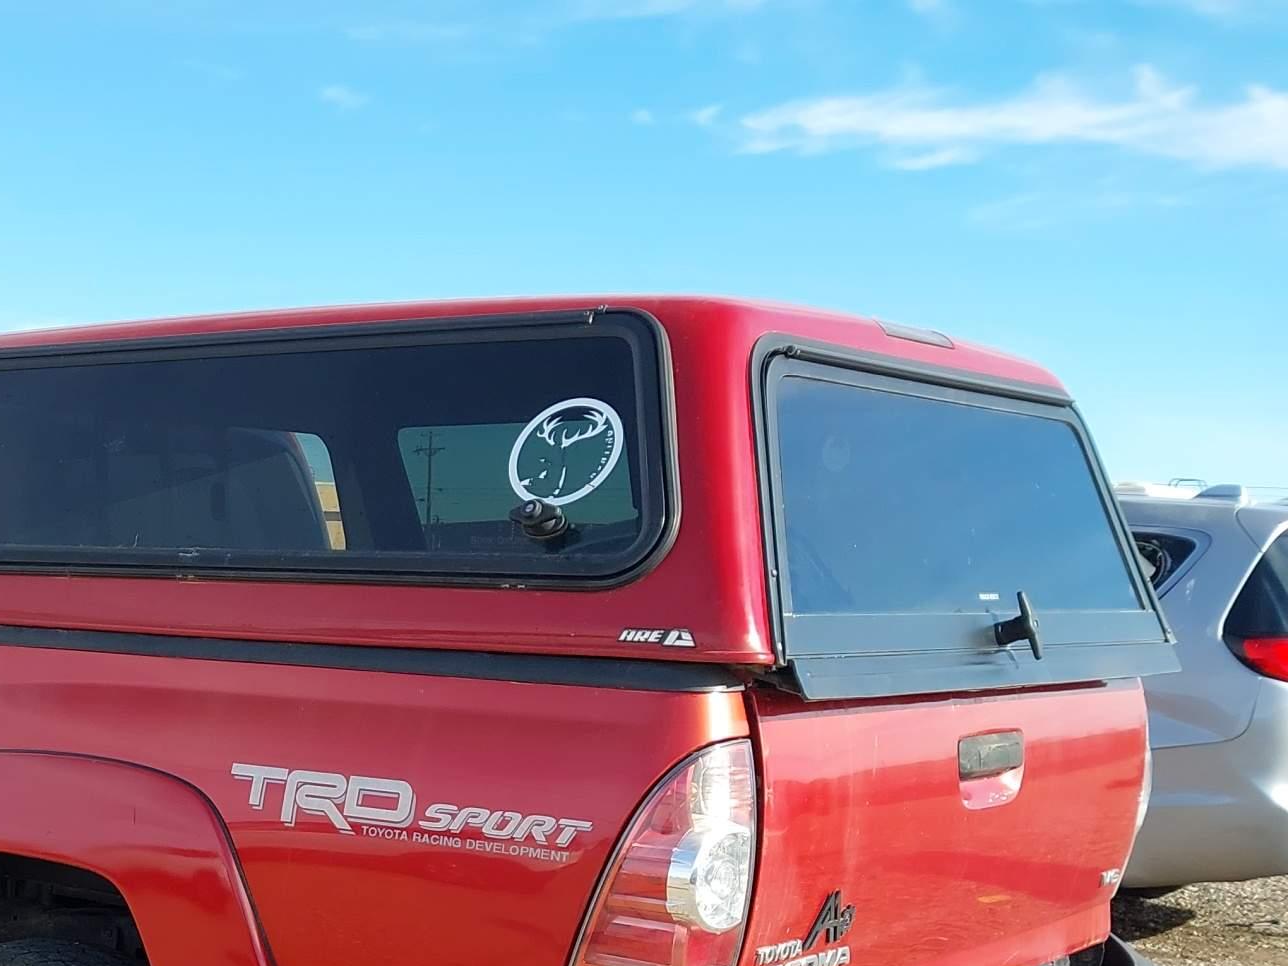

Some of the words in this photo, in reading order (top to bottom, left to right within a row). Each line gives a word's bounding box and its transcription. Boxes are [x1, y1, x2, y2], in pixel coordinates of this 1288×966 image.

[618, 629, 665, 642] ARE
[230, 762, 417, 836] TRD
[418, 803, 593, 848] SPORT
[361, 825, 409, 842] TOYOTA
[412, 832, 462, 848] RACING
[465, 838, 570, 863] DEVELOPMENT
[755, 940, 803, 966] TOYOTA
